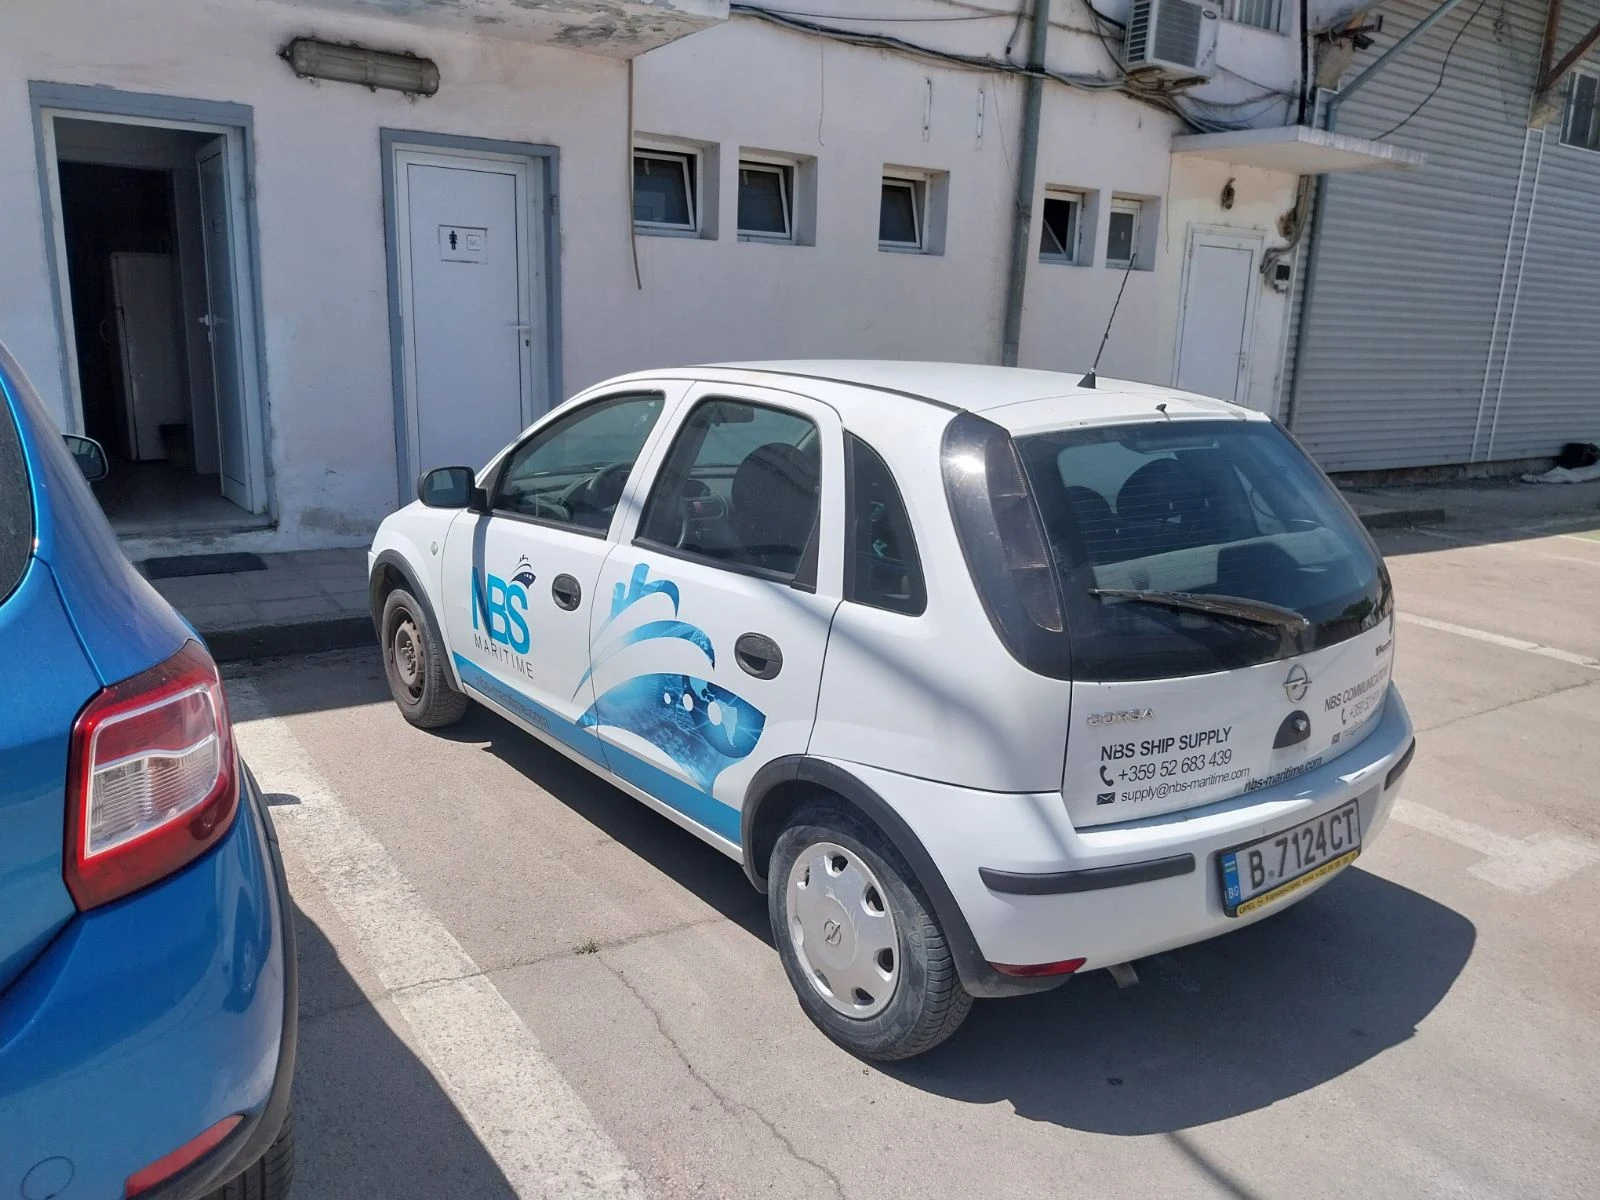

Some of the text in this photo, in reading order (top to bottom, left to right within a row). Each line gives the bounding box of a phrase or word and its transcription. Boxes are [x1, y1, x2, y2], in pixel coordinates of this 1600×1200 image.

[471, 566, 530, 655] NBS
[474, 633, 534, 679] MARITIME
[1087, 706, 1154, 726] CORSA
[1325, 693, 1342, 712] NBS
[1100, 726, 1232, 761] NBS SHIP SUPPLY
[1118, 748, 1232, 782] +359 52 683 439
[1244, 757, 1323, 792] nbs-maritime.com
[1121, 767, 1250, 803] supply@nbs-maritime.com
[1228, 885, 1240, 899] BG
